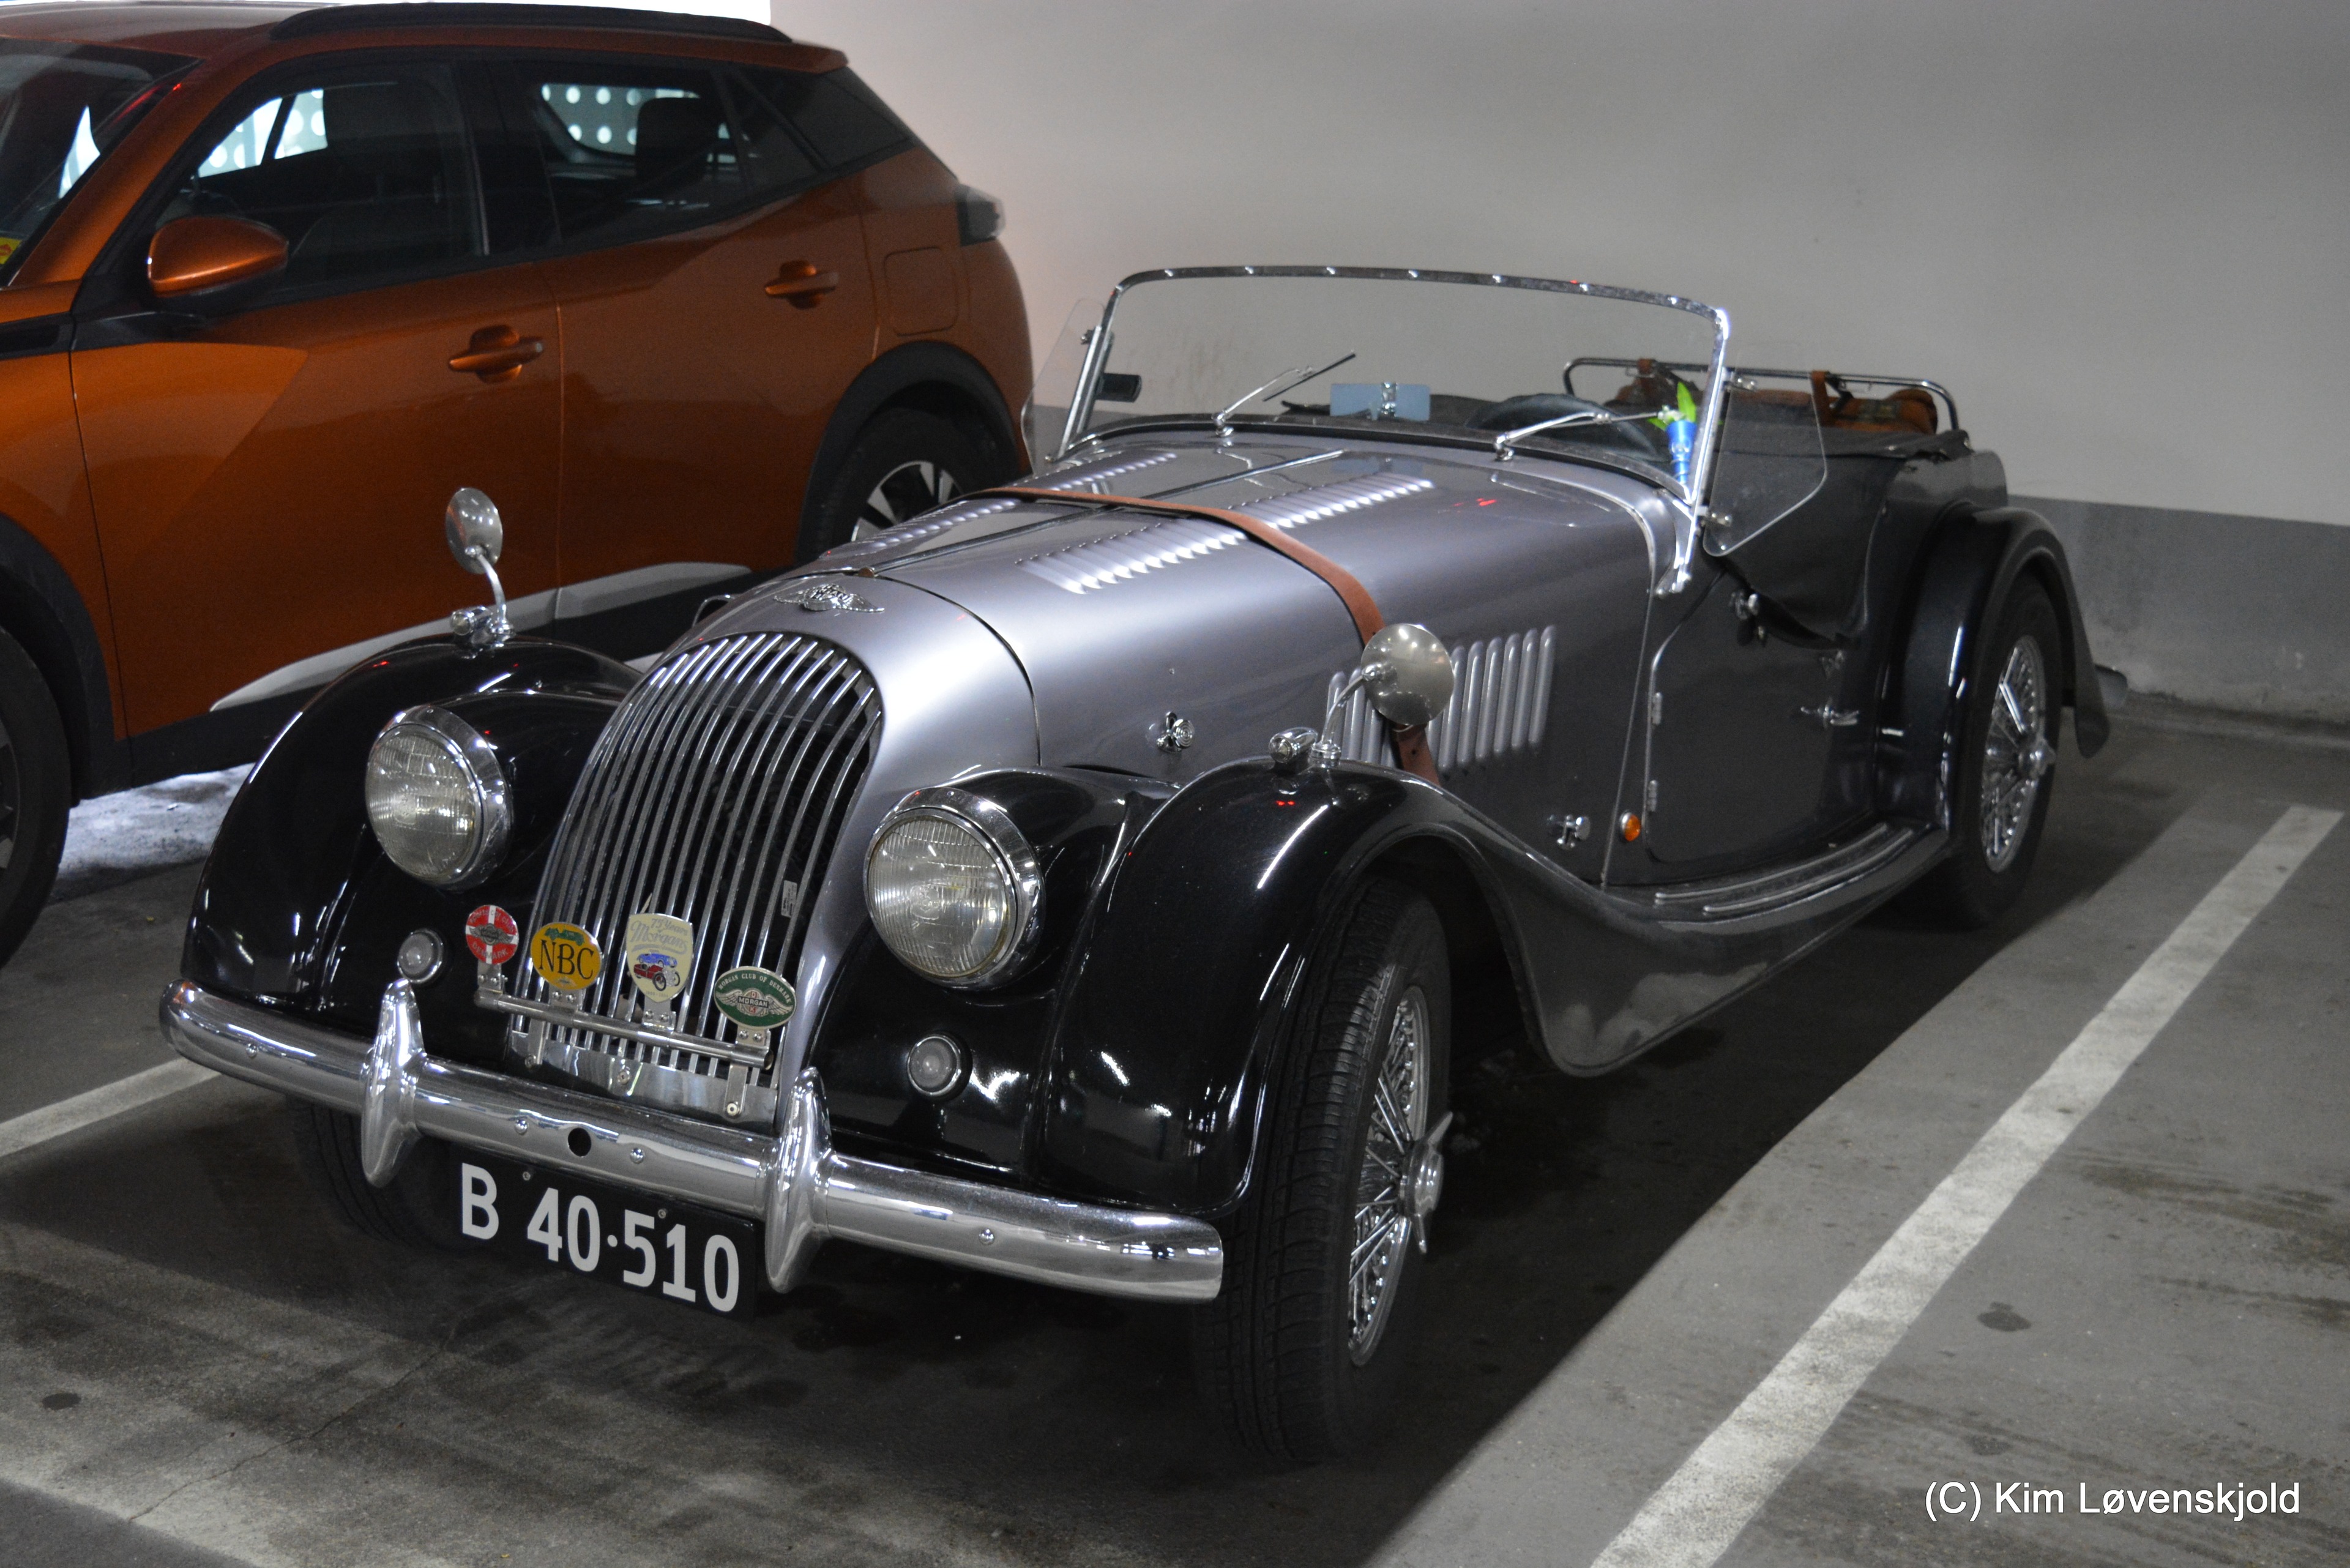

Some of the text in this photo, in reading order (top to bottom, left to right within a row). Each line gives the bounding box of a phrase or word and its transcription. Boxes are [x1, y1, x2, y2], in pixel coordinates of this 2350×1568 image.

[539, 939, 594, 979] NBC
[718, 974, 739, 990] MORGAN
[769, 980, 792, 1003] DENMARK
[738, 996, 769, 1007] MORGAN
[462, 1163, 499, 1240] B
